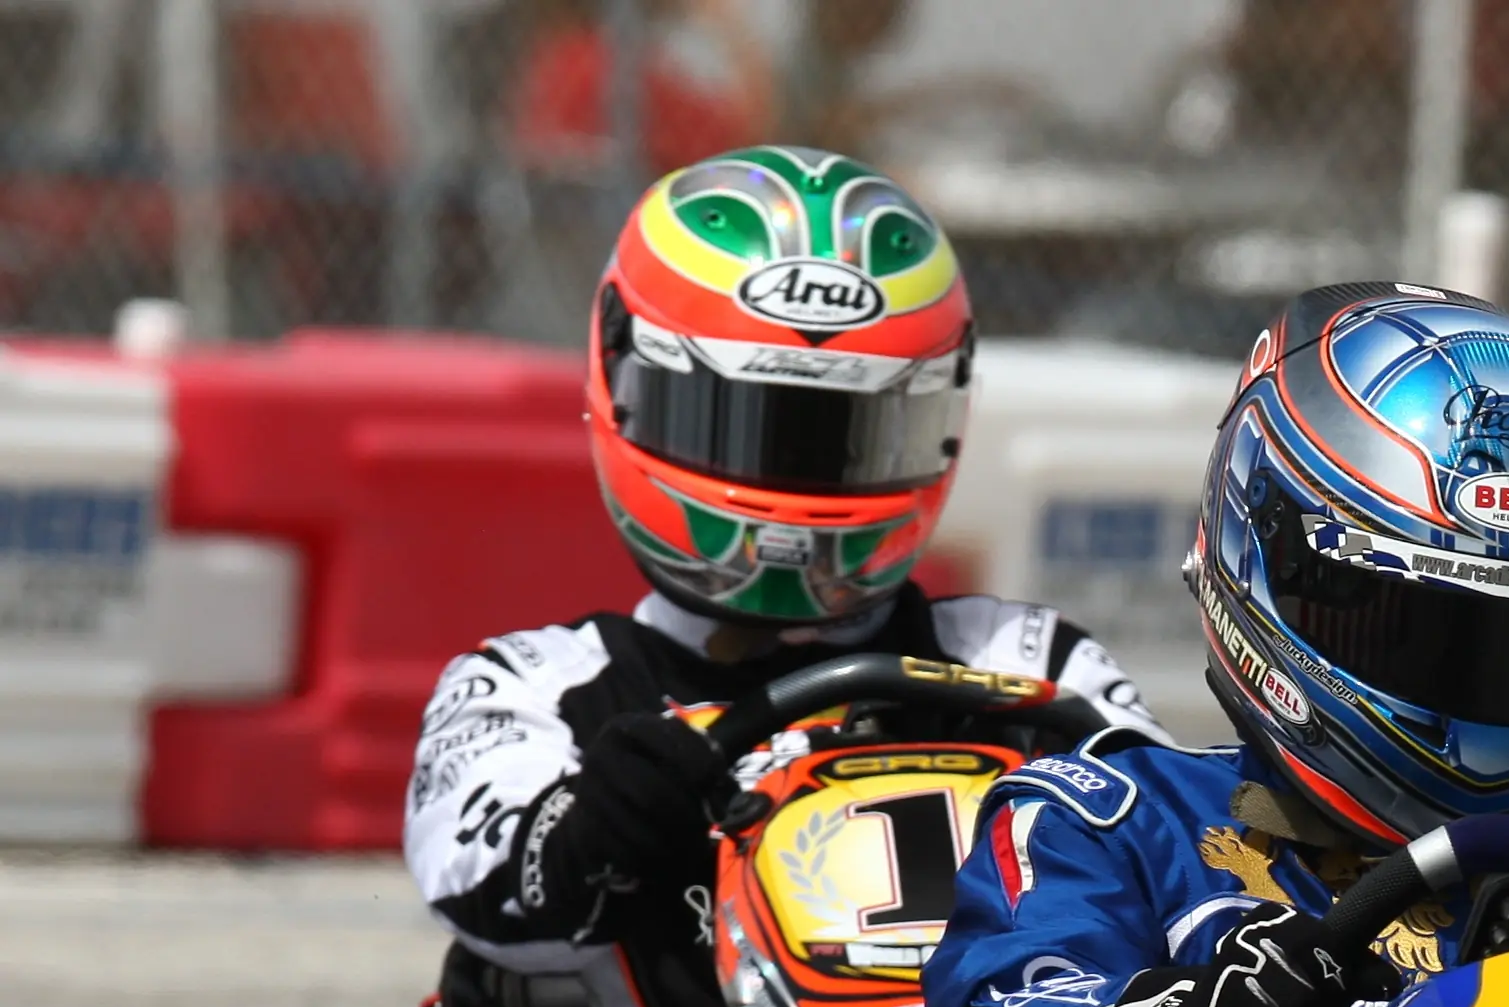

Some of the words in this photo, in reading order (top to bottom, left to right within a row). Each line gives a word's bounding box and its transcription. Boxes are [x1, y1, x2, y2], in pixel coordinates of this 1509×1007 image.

[750, 267, 867, 310] Arai
[1265, 676, 1301, 716] BELL
[834, 754, 978, 775] CRG
[848, 787, 968, 933] 1
